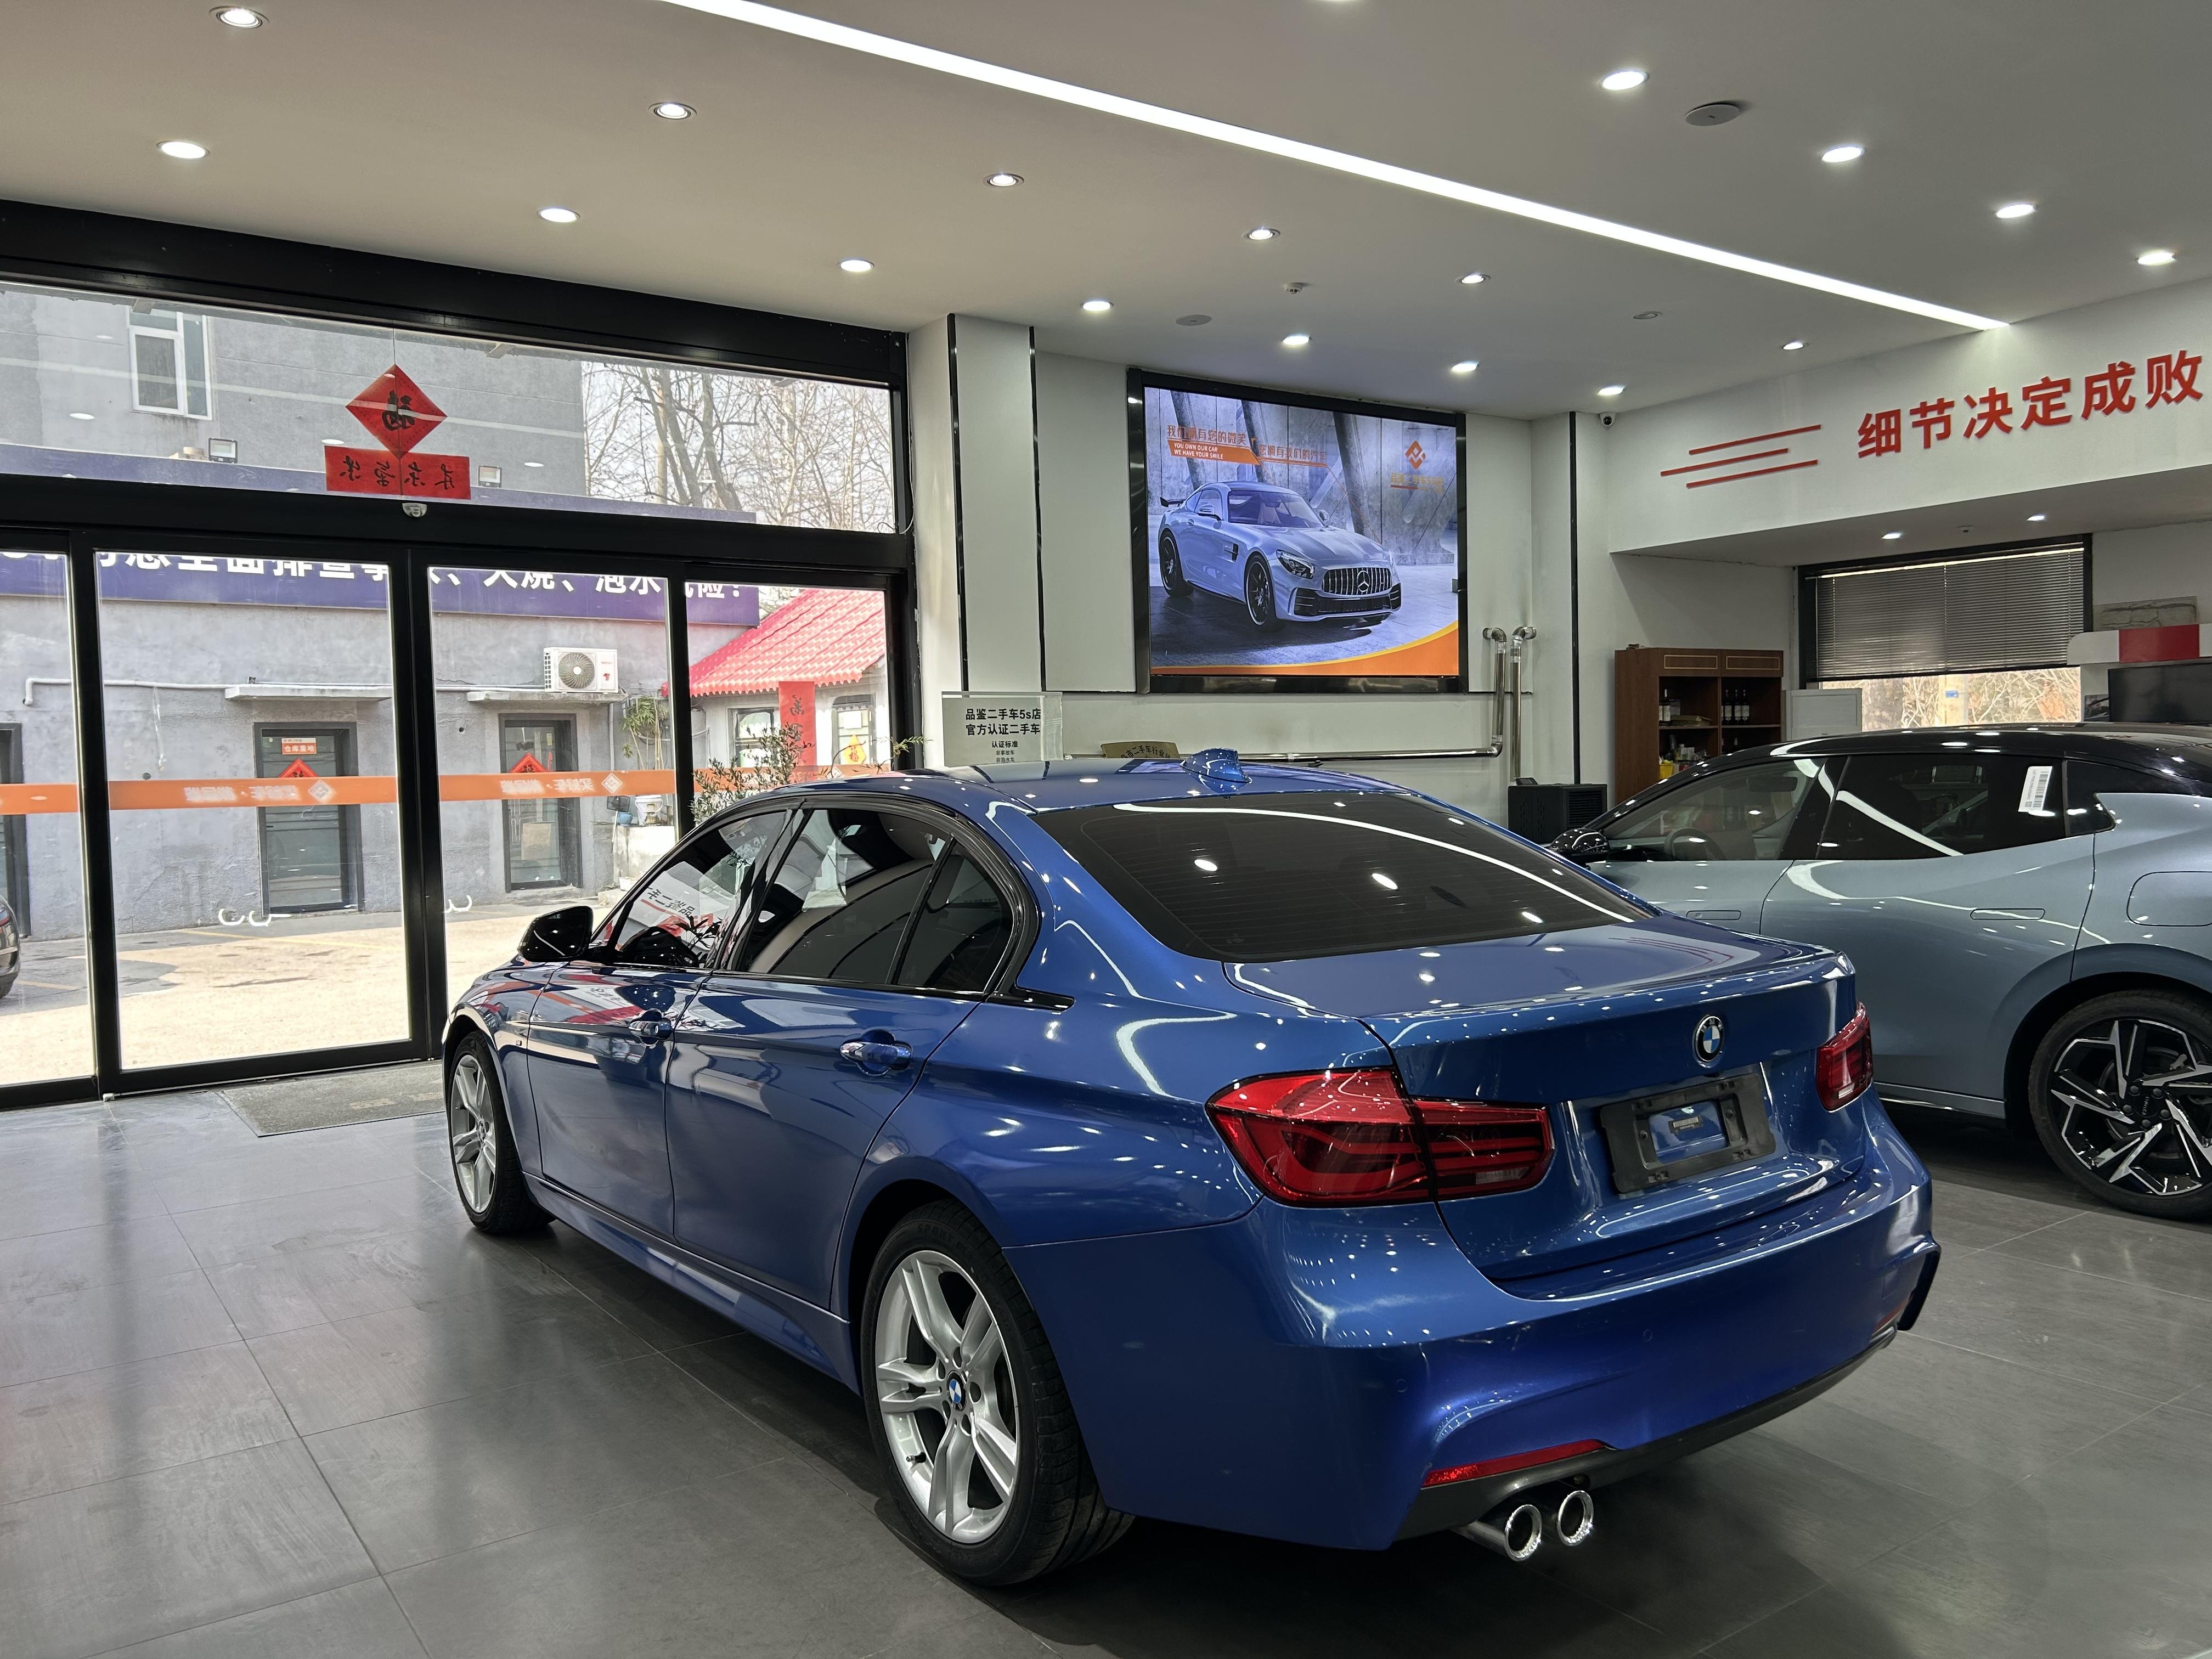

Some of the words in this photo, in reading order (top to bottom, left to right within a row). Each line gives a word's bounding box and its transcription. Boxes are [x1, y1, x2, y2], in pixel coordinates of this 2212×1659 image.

[1858, 349, 2203, 458] 细节决定成败
[966, 708, 1041, 720] 品鉴二手车5s店
[966, 723, 1041, 735] 官方认证二手车
